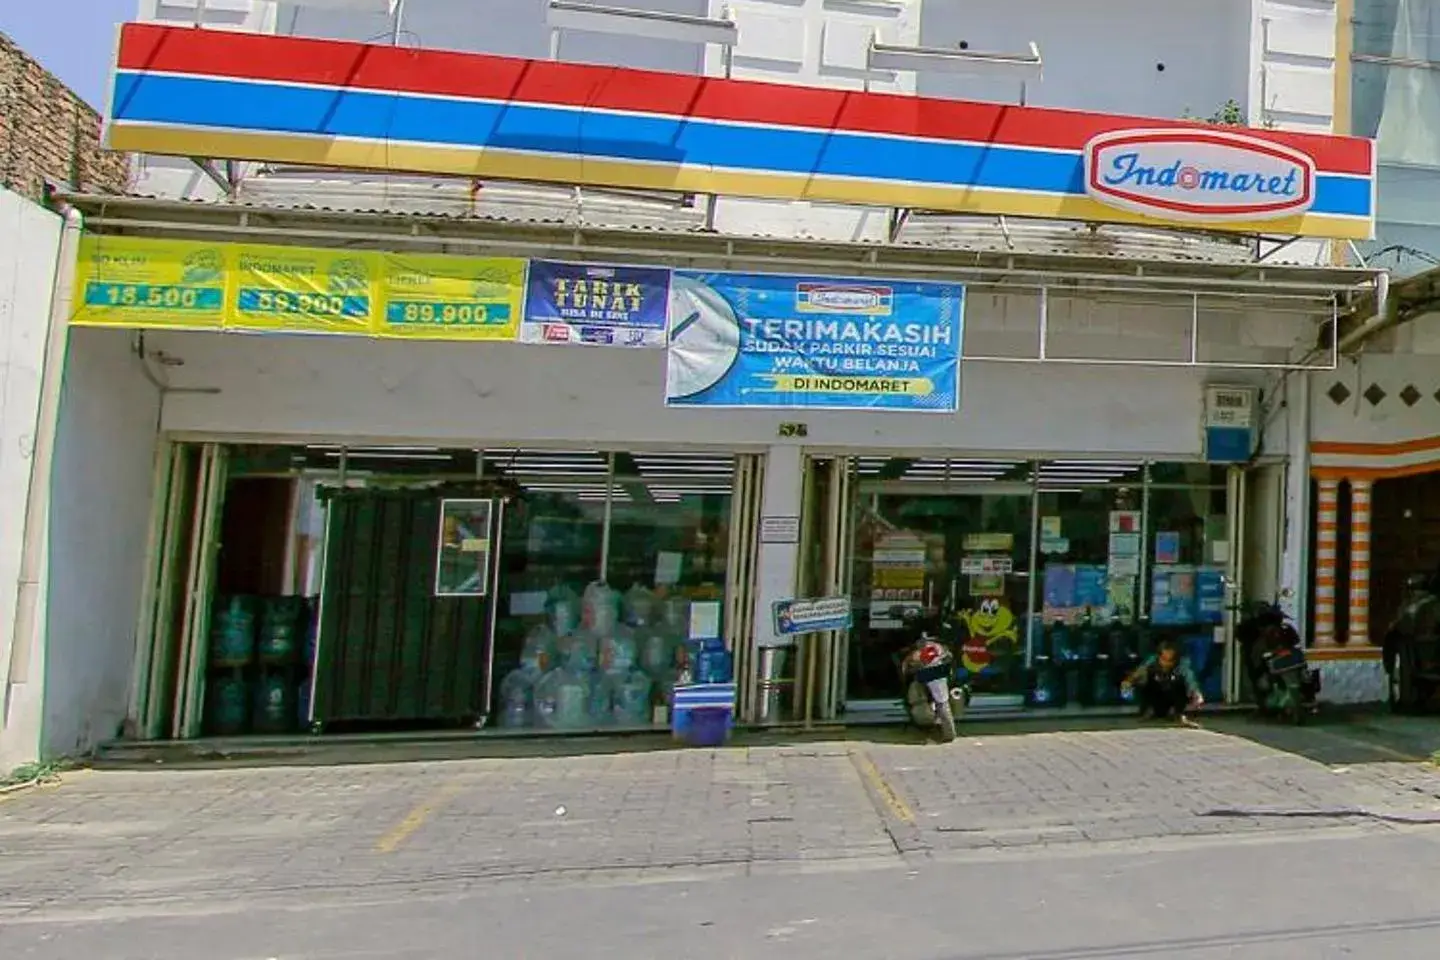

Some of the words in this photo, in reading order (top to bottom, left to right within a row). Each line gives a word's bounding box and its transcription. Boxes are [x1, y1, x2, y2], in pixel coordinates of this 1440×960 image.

[1104, 153, 1297, 197] Indomaret
[744, 317, 951, 345] TERIMAKASIH
[809, 341, 872, 356] PARKIR
[877, 343, 936, 358] SESUAI
[843, 356, 920, 372] BELANJA
[793, 377, 810, 390] DI
[813, 378, 910, 392] INDOMARET
